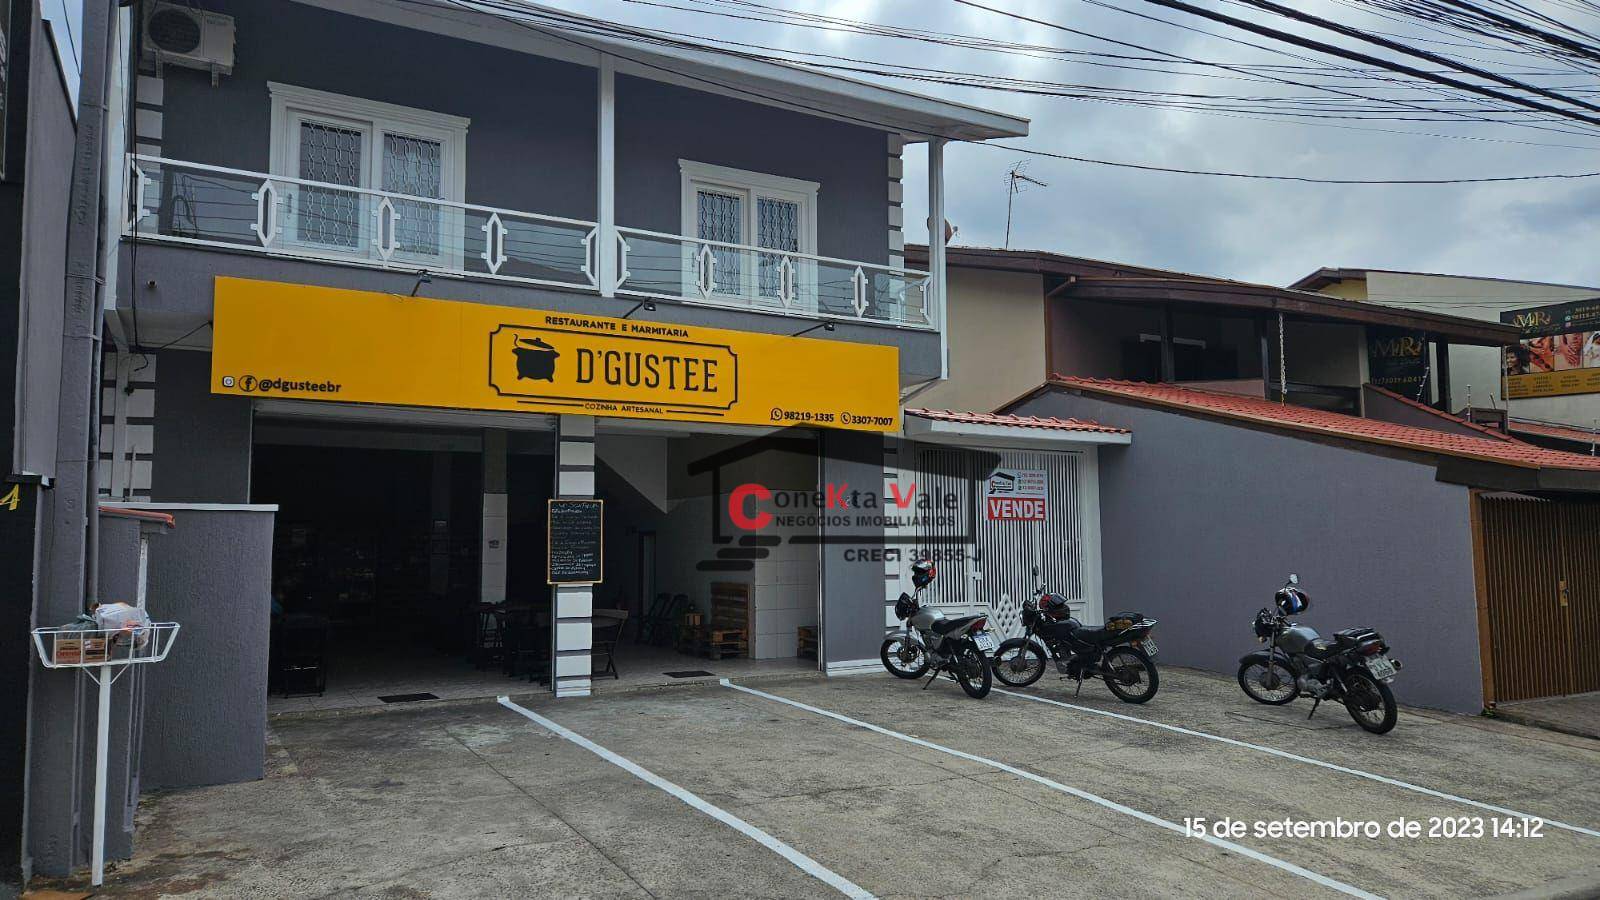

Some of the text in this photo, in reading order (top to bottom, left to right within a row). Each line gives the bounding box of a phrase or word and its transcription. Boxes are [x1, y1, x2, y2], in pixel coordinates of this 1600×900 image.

[545, 316, 689, 338] RESTAURANTE E MARMITARIA
[575, 347, 718, 393] D'GUSTEE
[258, 377, 342, 393] @dgusteebr
[584, 403, 664, 415] COZINHA ARTESANAL
[784, 411, 835, 423] 98219-1335
[851, 415, 893, 426] 3307-7007
[990, 499, 1044, 519] VENDE
